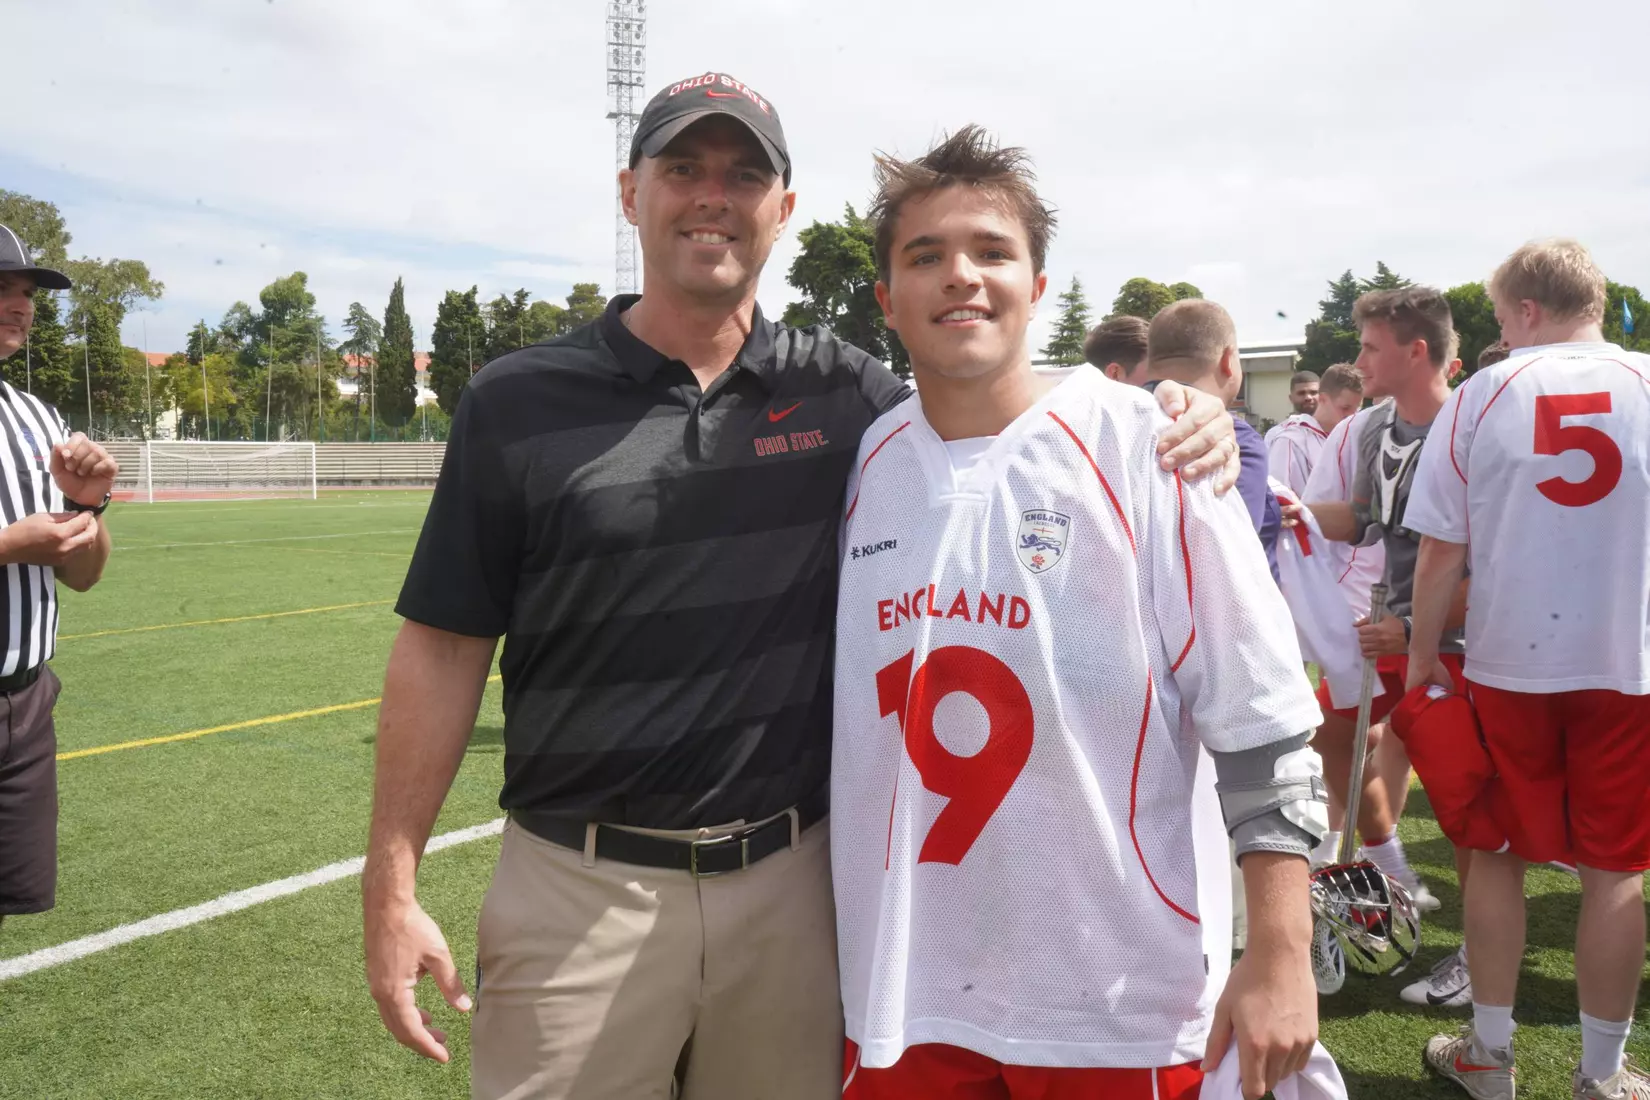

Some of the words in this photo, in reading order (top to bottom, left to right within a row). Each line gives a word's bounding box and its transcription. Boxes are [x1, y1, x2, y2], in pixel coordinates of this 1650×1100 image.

[669, 74, 716, 96] OHIO
[721, 75, 770, 116] STATE
[754, 435, 788, 456] OHIO
[790, 429, 824, 451] STATE
[1533, 391, 1622, 507] 5
[1025, 513, 1067, 527] ENGLAND
[862, 539, 897, 557] KUKRI
[878, 584, 1031, 631] ENGLAND
